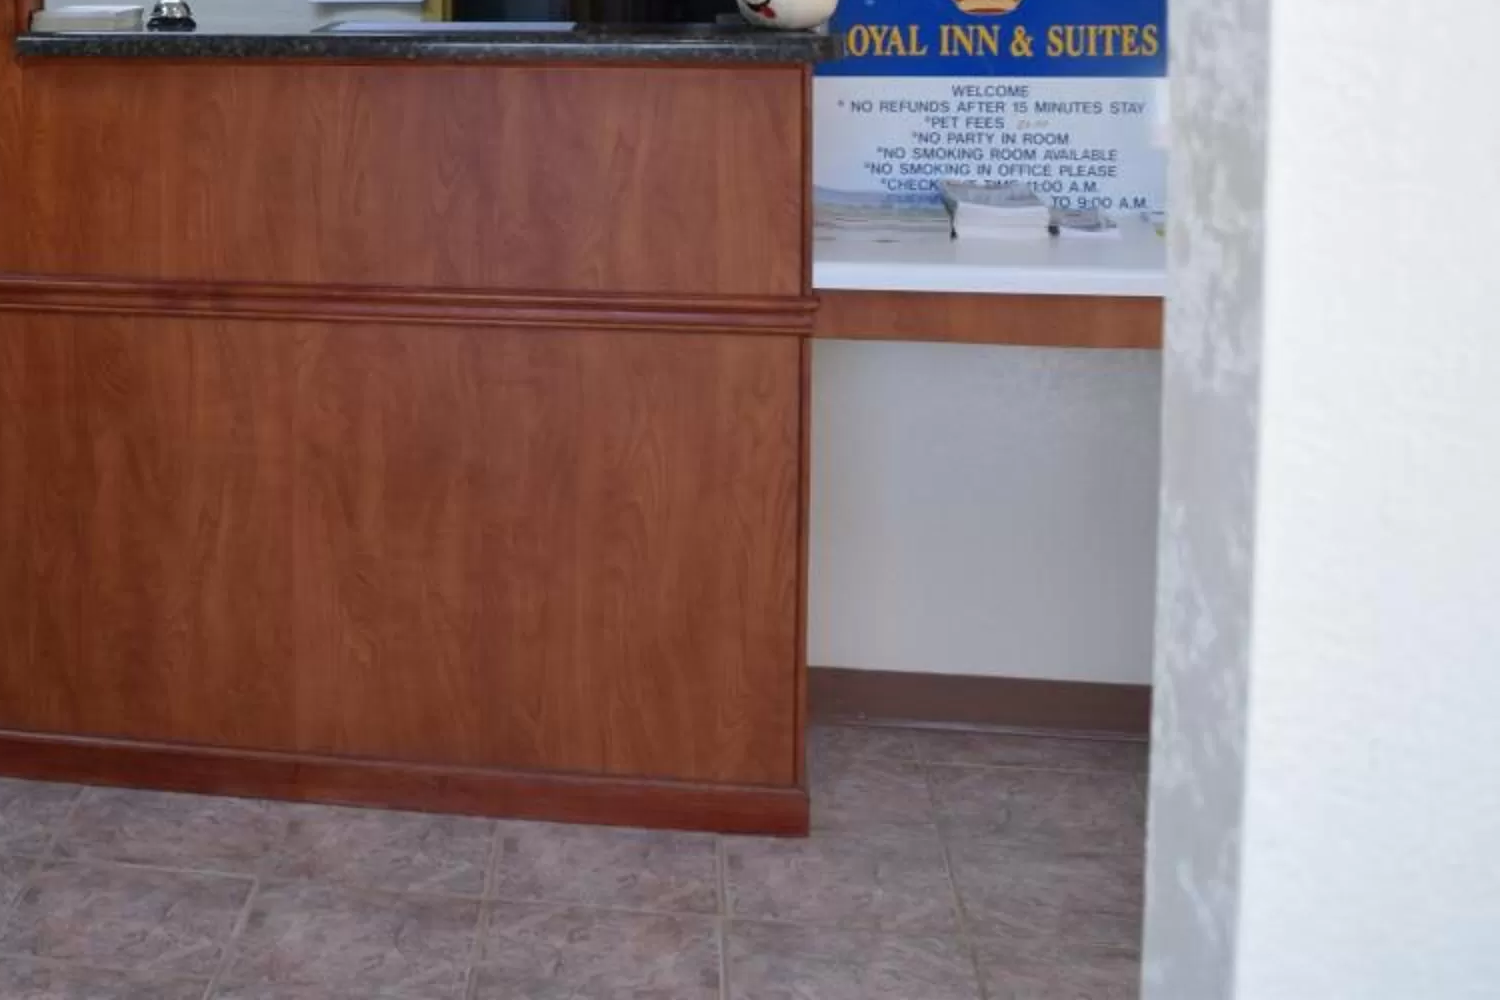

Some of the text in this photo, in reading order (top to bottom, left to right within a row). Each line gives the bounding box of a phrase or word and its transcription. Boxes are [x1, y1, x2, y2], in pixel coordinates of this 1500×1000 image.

[845, 24, 1159, 58] OYAL INN & SUITES
[951, 85, 1030, 98] WELCOME
[851, 101, 1146, 114] NO REFUNDS AFTER 15 MINUTES STAY
[965, 117, 1005, 129] FEES
[947, 132, 995, 145] PARTY
[1001, 133, 1018, 145] IN
[1023, 133, 1069, 145] ROOM
[912, 148, 984, 161] SMOKING
[990, 148, 1036, 161] ROOM
[1042, 149, 1118, 162] AVAILABLE
[899, 163, 971, 176] SMOKING
[977, 164, 992, 176] IN
[998, 164, 1052, 177] OFFICE
[1059, 165, 1118, 177] PLEASE
[1051, 196, 1072, 209] TO
[1078, 196, 1112, 209] 9:00
